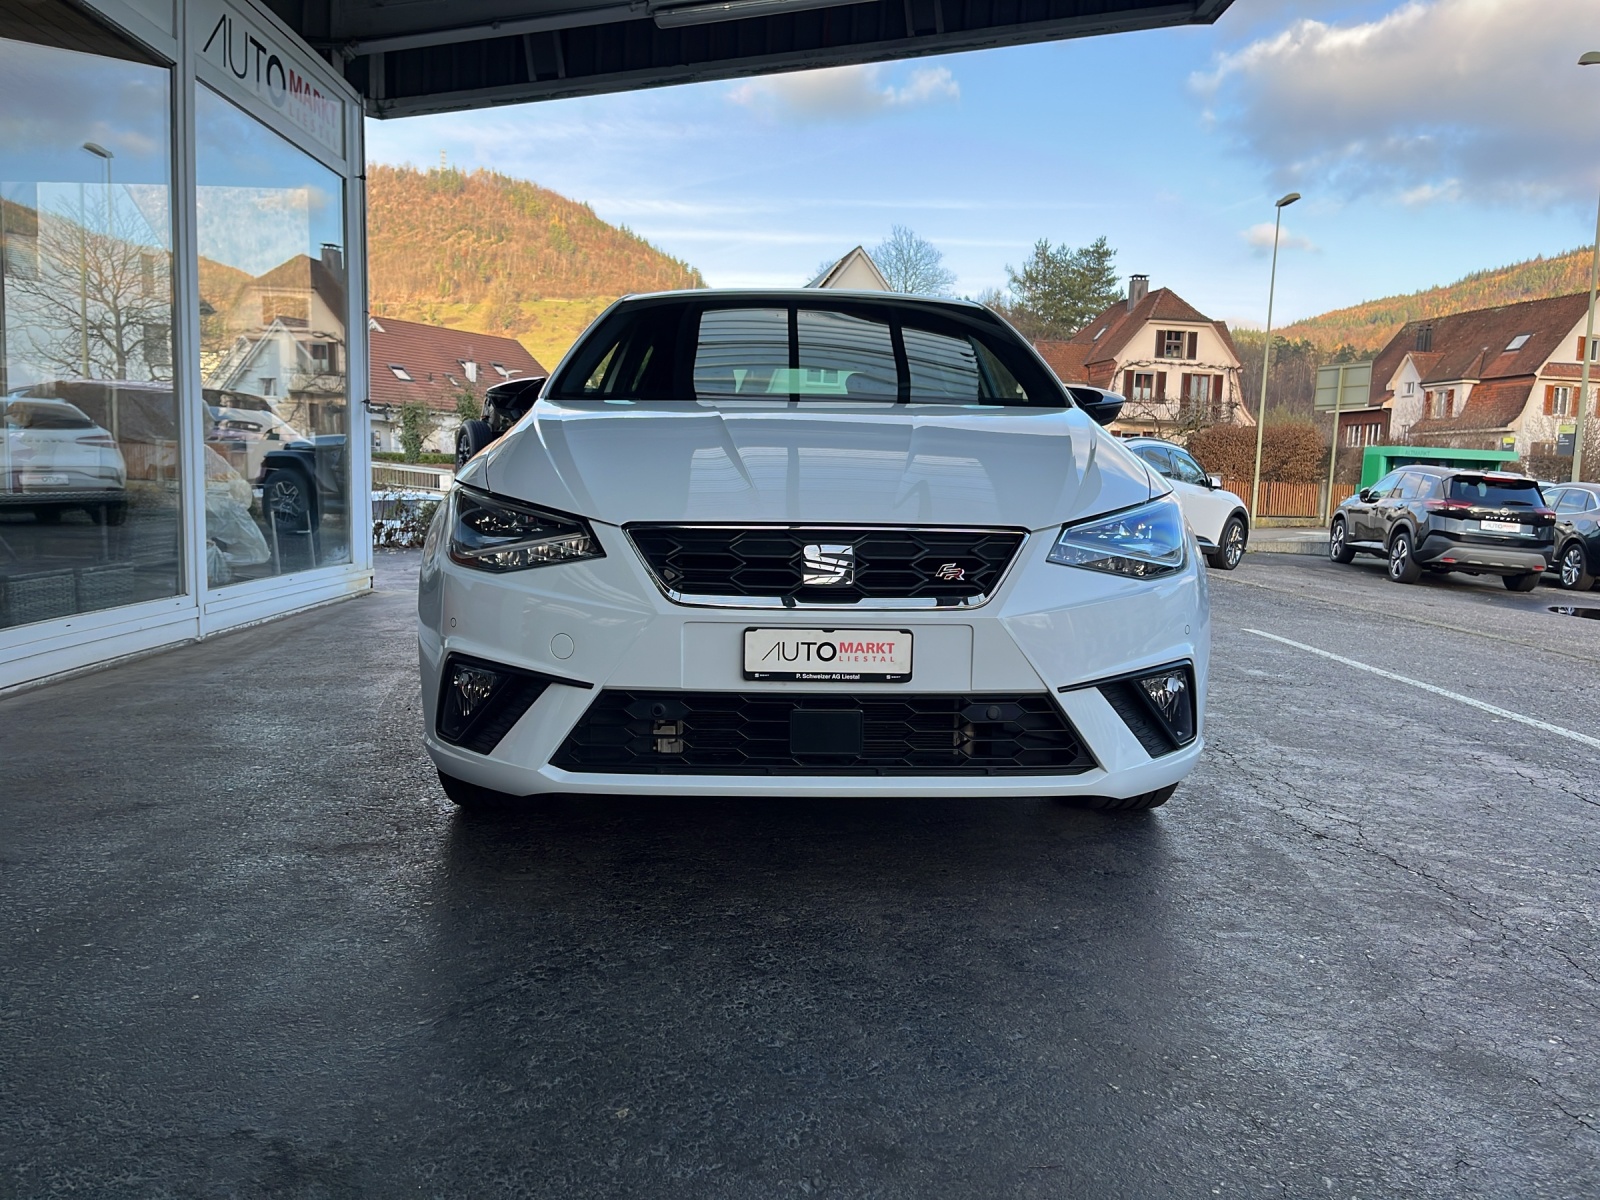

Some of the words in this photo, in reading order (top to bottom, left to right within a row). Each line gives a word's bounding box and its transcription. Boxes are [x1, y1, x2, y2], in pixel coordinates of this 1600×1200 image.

[203, 14, 287, 108] AUTO
[289, 68, 337, 128] MARKT
[289, 102, 337, 150] LIESTAL
[935, 563, 965, 581] FR
[762, 641, 837, 662] AUTO
[839, 642, 895, 654] MARKT
